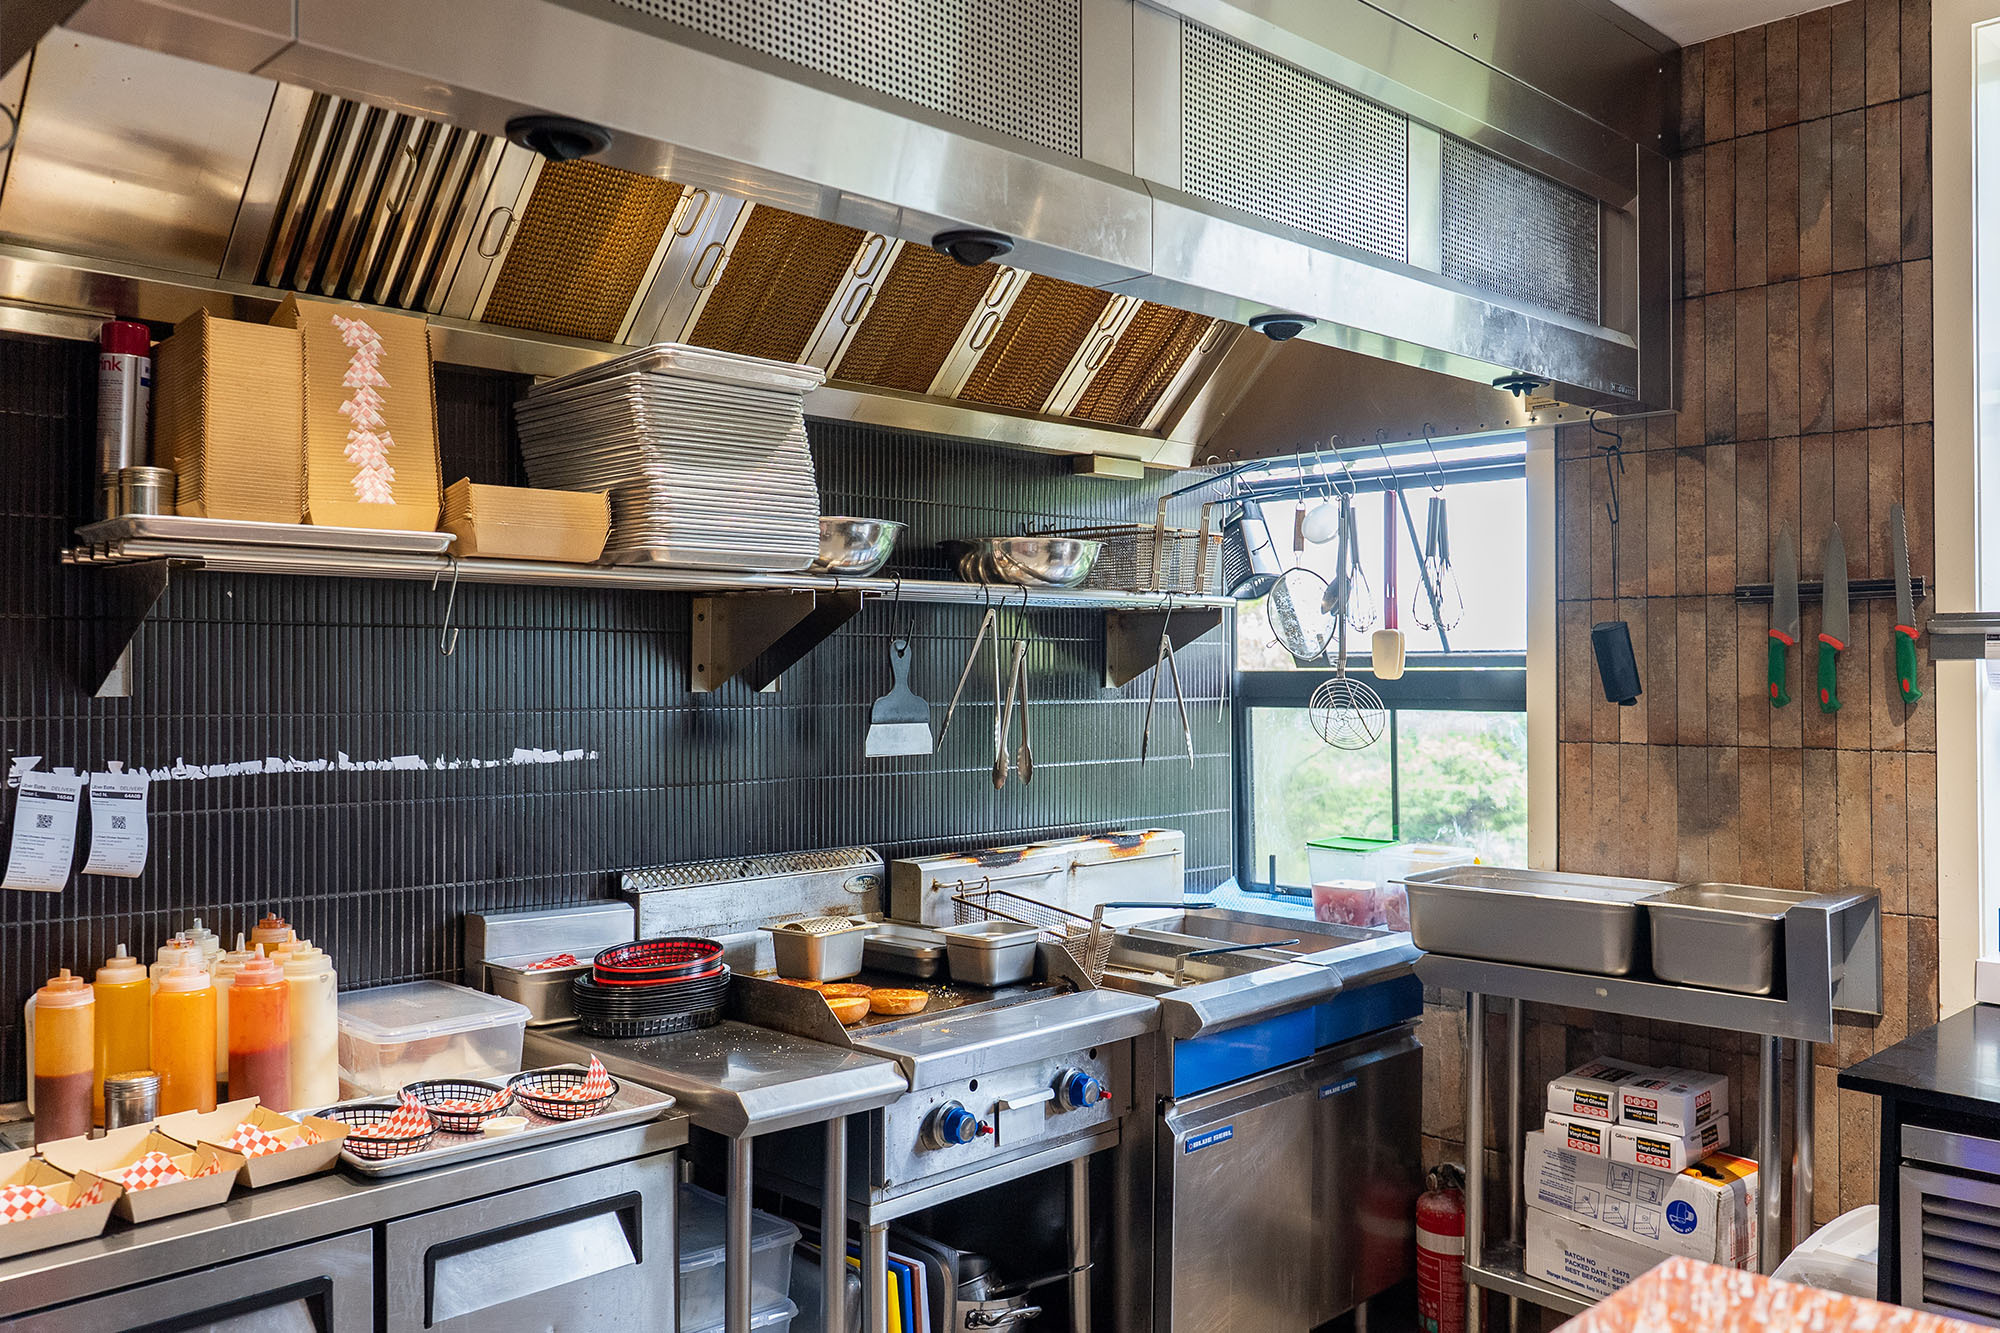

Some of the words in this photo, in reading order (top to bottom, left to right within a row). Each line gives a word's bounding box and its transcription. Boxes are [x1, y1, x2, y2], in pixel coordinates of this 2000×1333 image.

[1325, 1085, 1340, 1095] BLUE
[1576, 1095, 1588, 1103] Vinyl
[1588, 1098, 1606, 1106] Gloves
[1625, 1107, 1642, 1115] Gloves
[1193, 1137, 1212, 1148] BLUE
[1213, 1130, 1232, 1141] SEAL
[1569, 1130, 1581, 1138] Vinyl
[1581, 1133, 1598, 1142] Gloves
[1638, 1144, 1650, 1152] Vinyl
[1650, 1146, 1668, 1155] Gloves
[1564, 1250, 1585, 1261] BATCH
[1585, 1258, 1596, 1266] NO
[1564, 1258, 1590, 1271] PACKED
[1611, 1275, 1625, 1284] SEP
[1564, 1266, 1580, 1276] BEST
[1581, 1272, 1606, 1285] BEFORE
